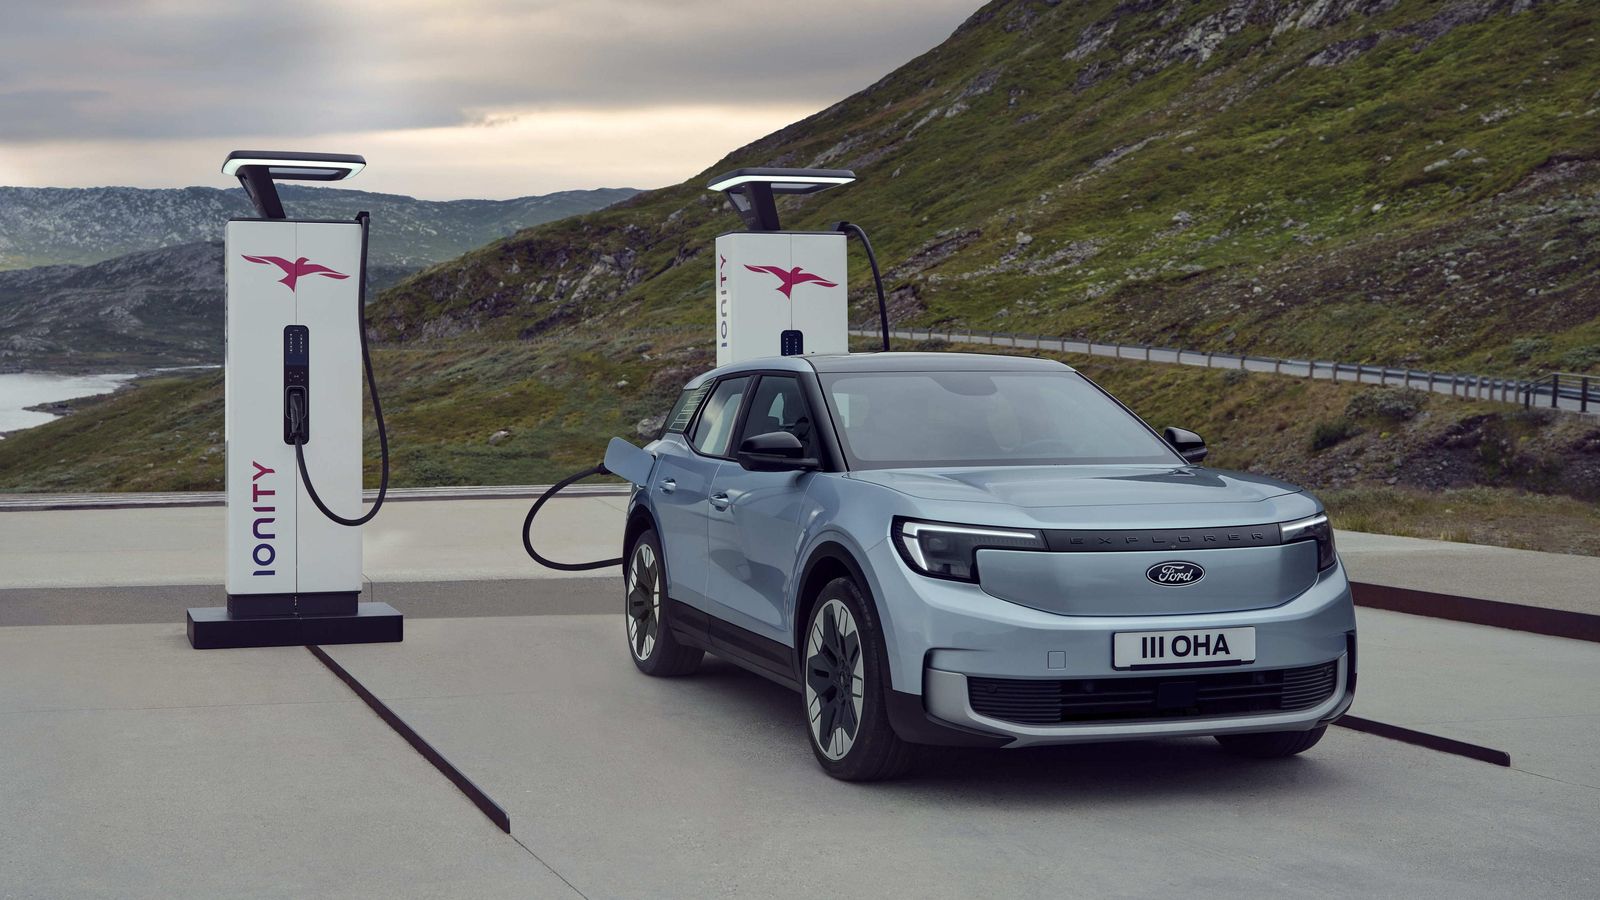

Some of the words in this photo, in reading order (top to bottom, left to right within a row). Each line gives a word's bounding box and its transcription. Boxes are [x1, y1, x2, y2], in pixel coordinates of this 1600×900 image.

[252, 460, 276, 576] IONITY
[1069, 532, 1264, 544] EXPLORER
[1158, 564, 1194, 582] Ford
[1171, 633, 1231, 658] OHA
